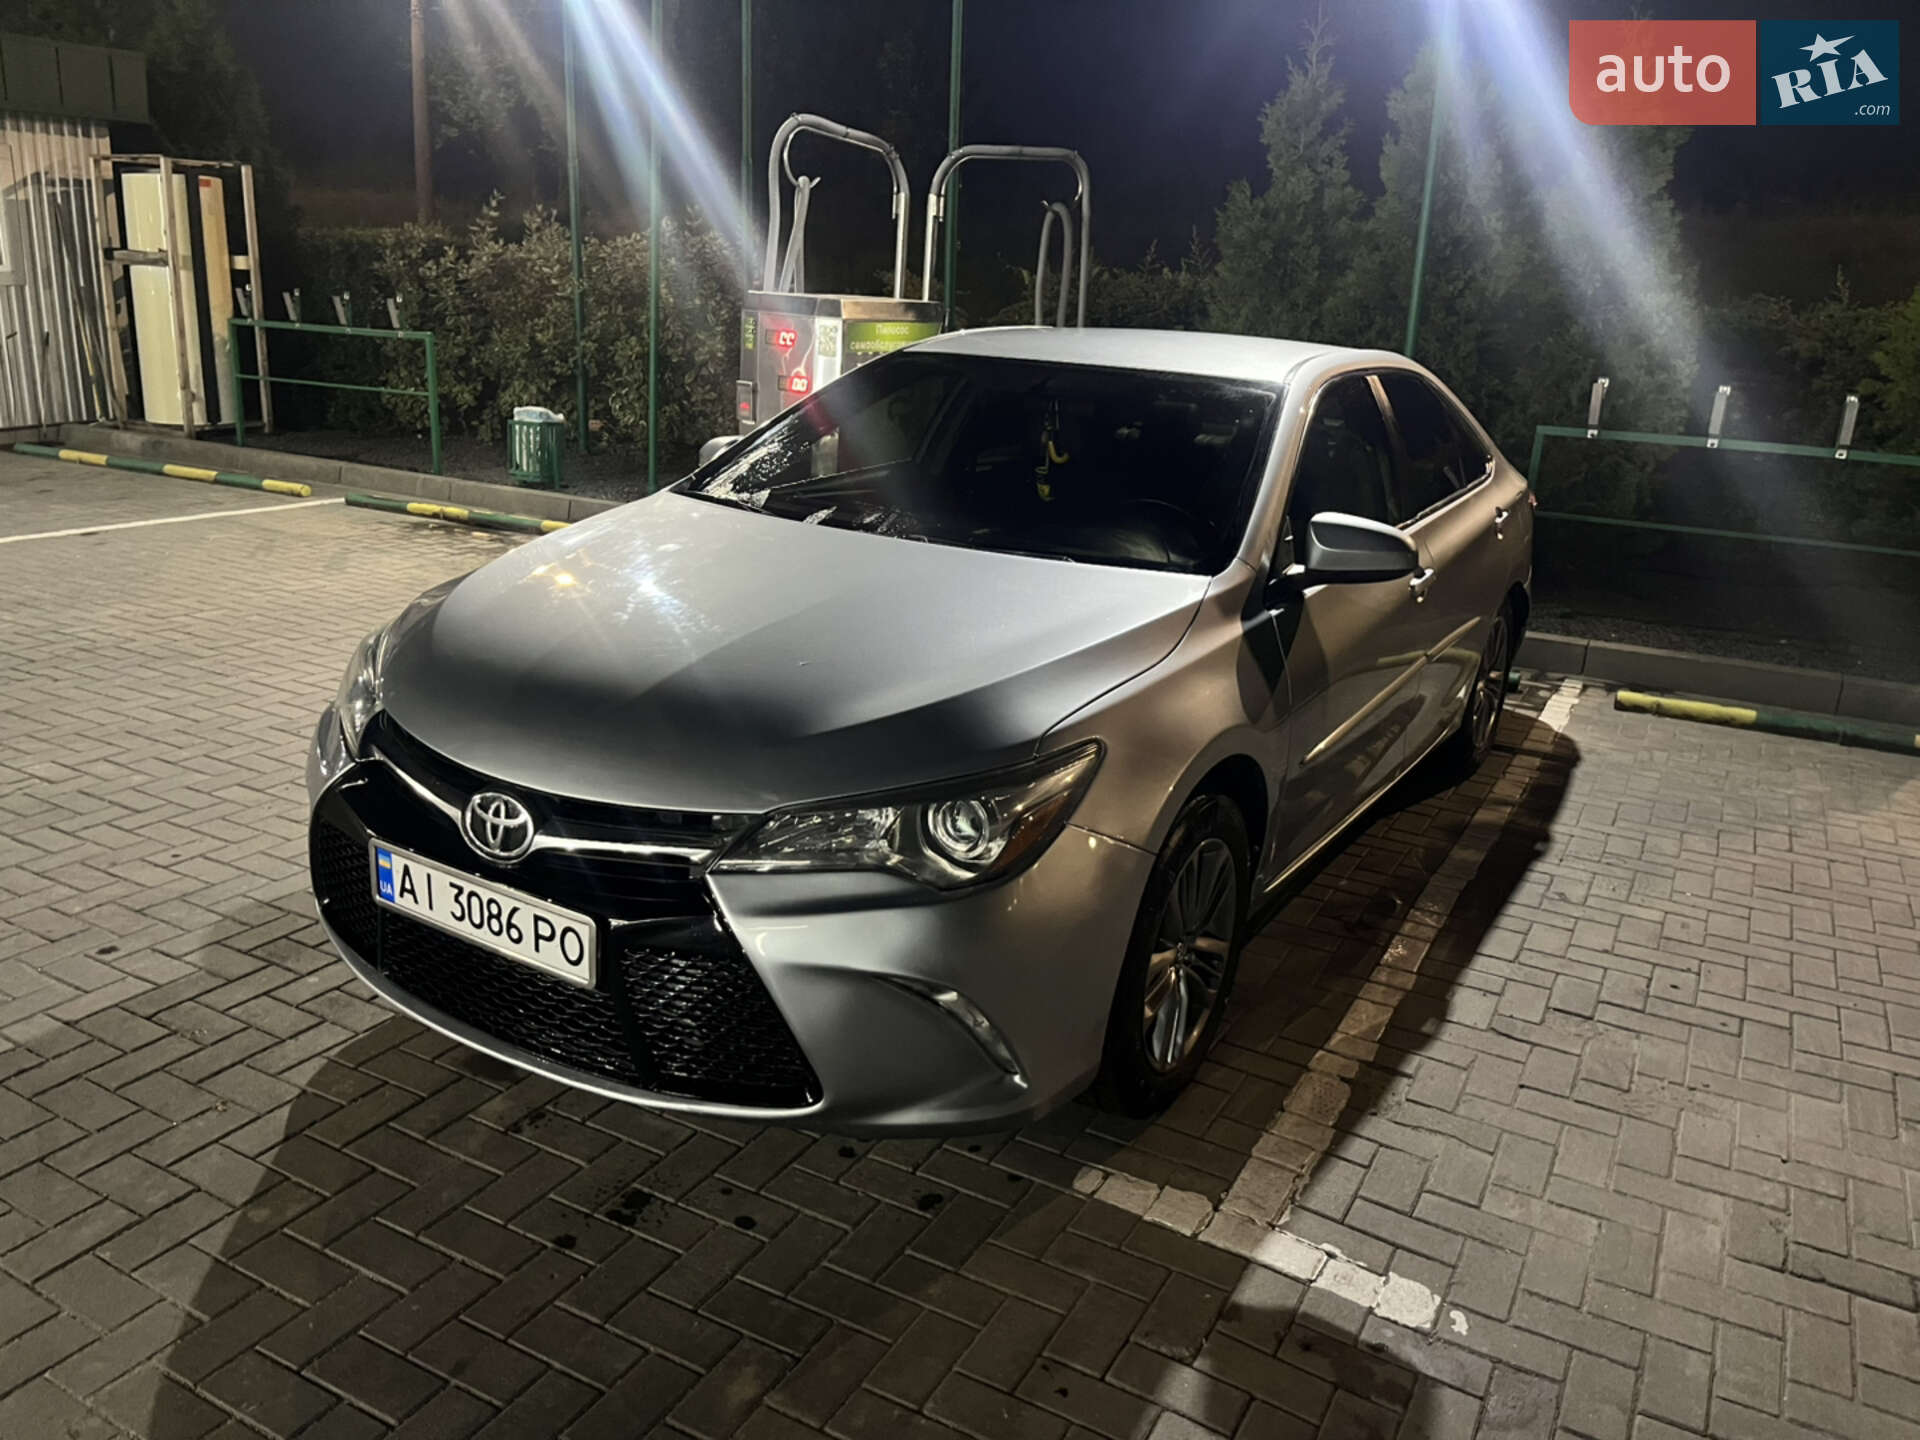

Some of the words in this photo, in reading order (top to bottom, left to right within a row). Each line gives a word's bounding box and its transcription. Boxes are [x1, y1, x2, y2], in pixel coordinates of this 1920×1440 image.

[379, 881, 394, 896] UA
[399, 863, 434, 911] AI
[448, 881, 524, 945] 3086
[532, 912, 585, 967] PO
